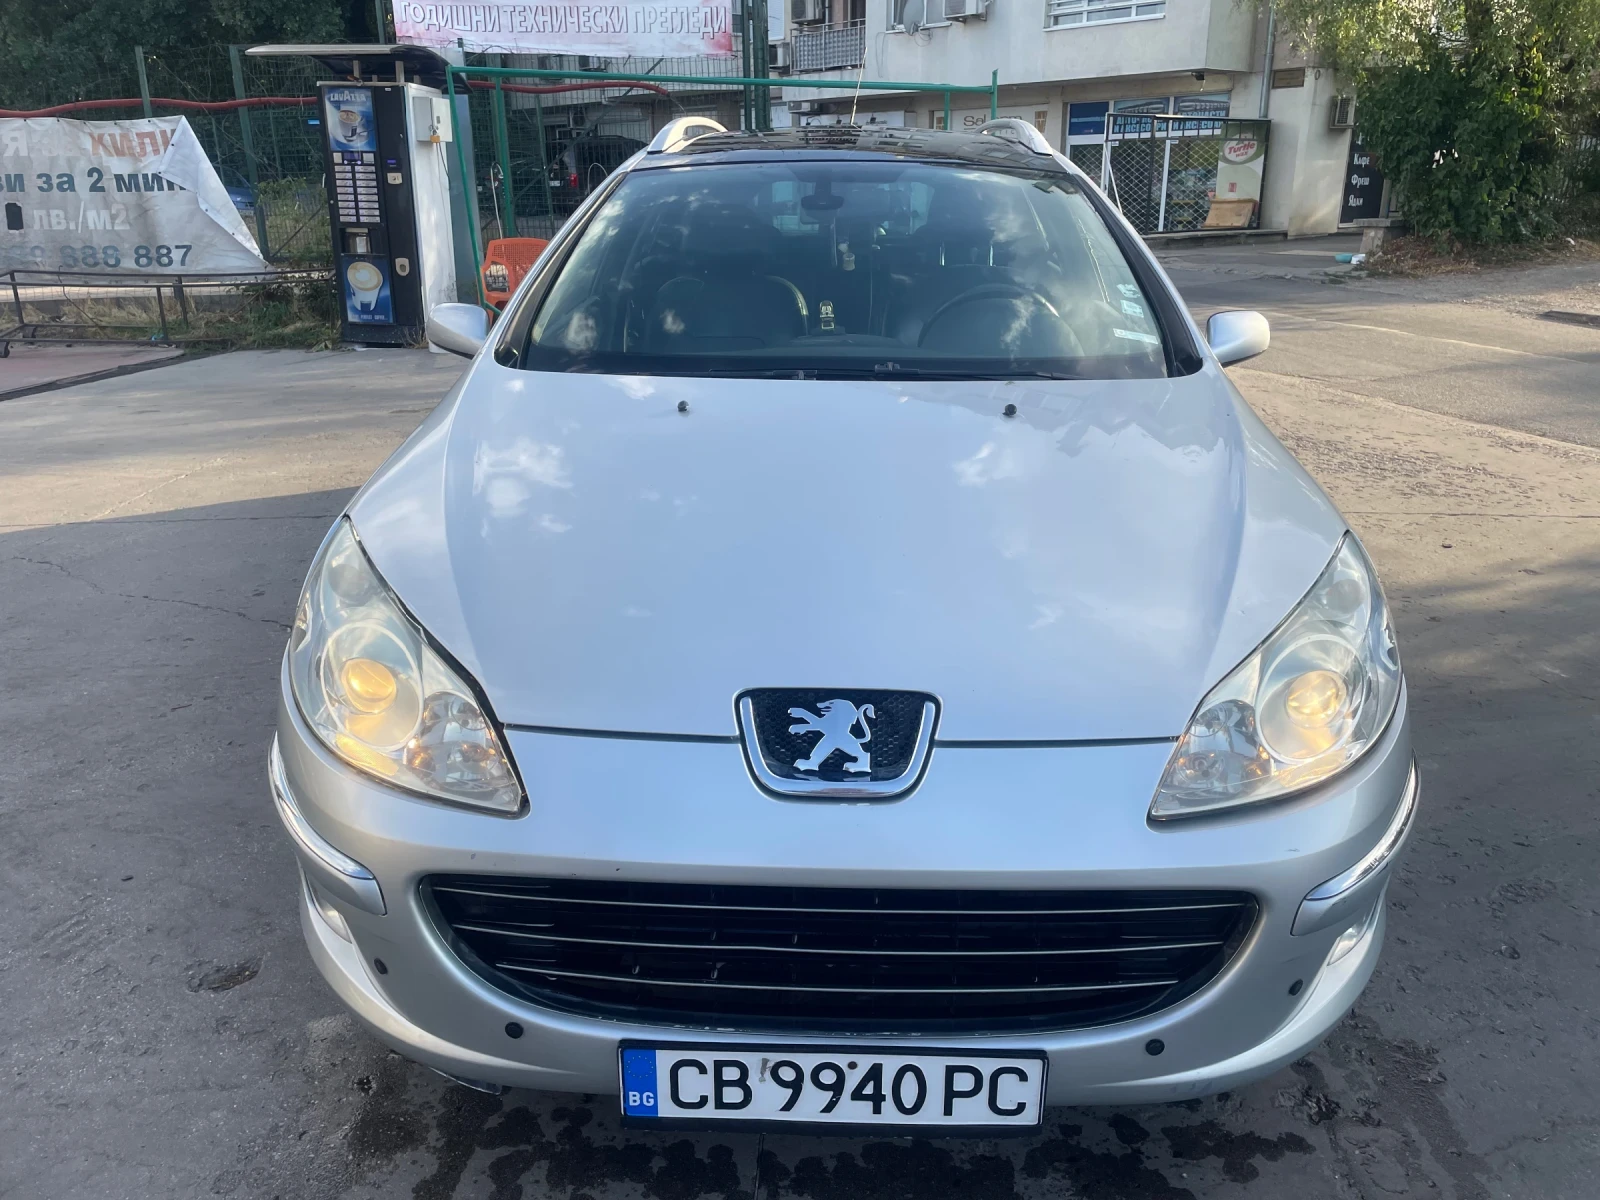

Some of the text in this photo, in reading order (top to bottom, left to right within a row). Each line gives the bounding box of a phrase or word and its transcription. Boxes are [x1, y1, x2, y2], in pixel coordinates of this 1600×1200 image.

[401, 2, 727, 40] ГОДИШНИ ТЕХНИЧЕСКИ ПРЕГЛЕДИ
[1228, 141, 1256, 155] Turtle
[36, 172, 76, 193] за
[87, 166, 106, 193] 2
[134, 244, 193, 268] 887
[628, 1091, 655, 1107] BG
[669, 1058, 1029, 1117] CB 9940 PC
